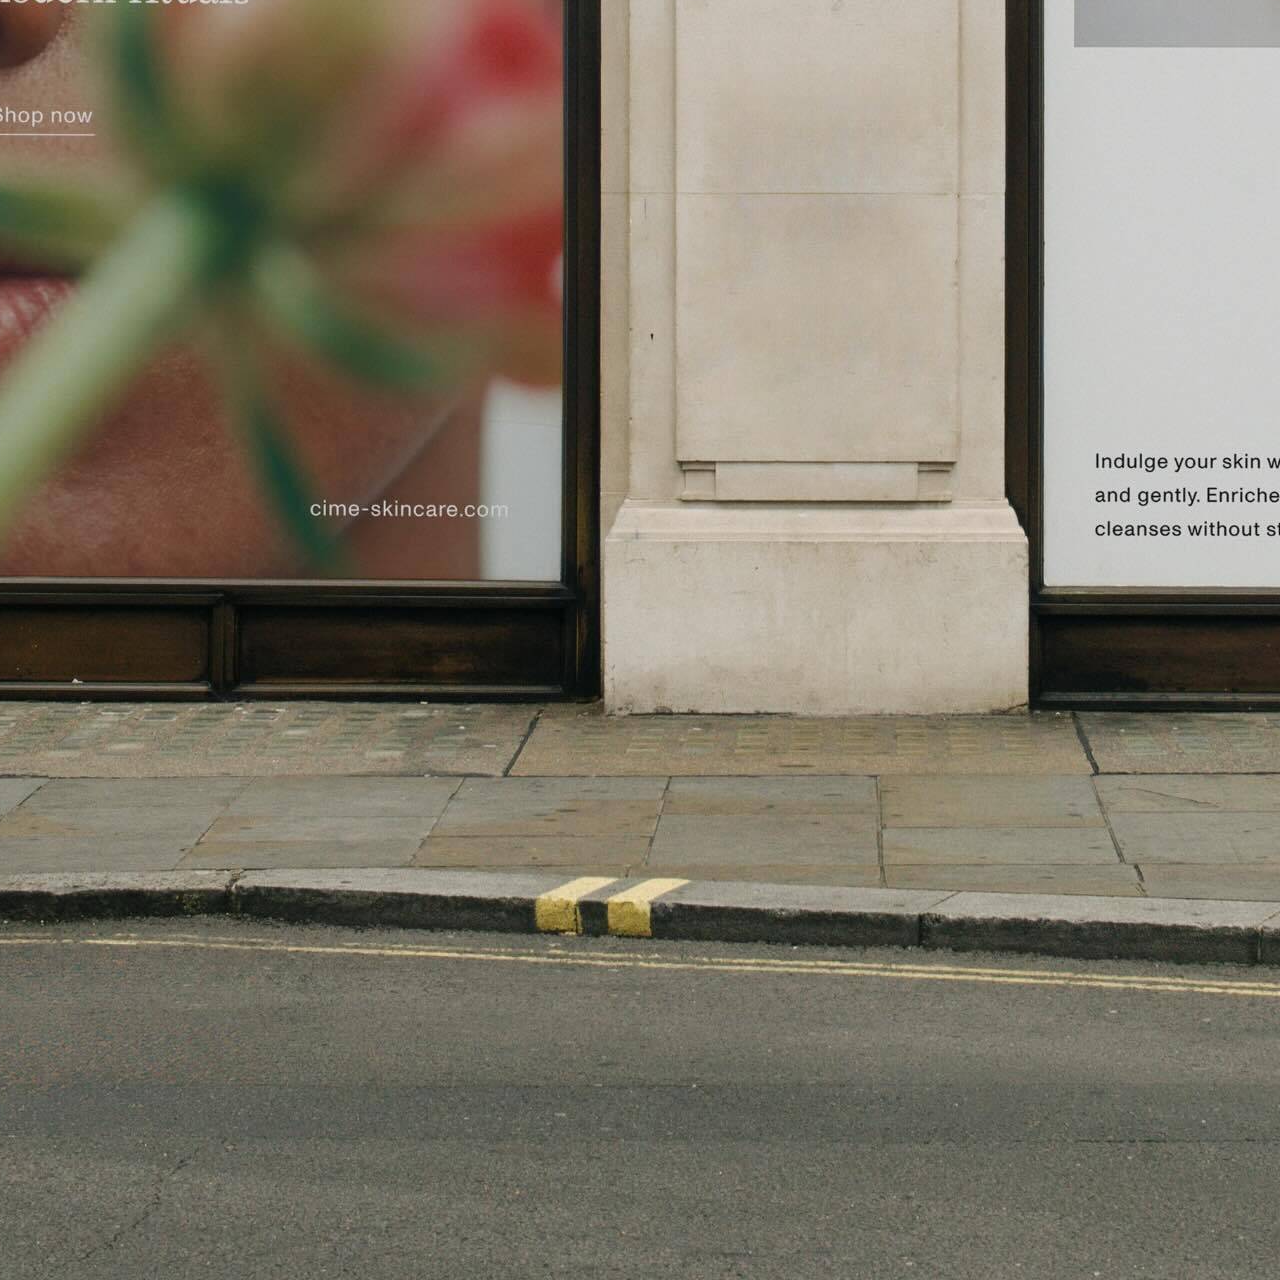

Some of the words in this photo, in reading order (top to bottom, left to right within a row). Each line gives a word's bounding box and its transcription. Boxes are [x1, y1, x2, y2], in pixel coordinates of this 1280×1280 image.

[51, 110, 93, 124] now
[1095, 452, 1169, 473] Indulge
[1173, 456, 1218, 473] your
[1222, 452, 1261, 470] skin
[1094, 486, 1131, 503] and
[1137, 487, 1201, 507] gently.
[310, 499, 510, 518] cime-skincare.com
[1094, 520, 1182, 537] cleanses
[1187, 520, 1261, 537] without
